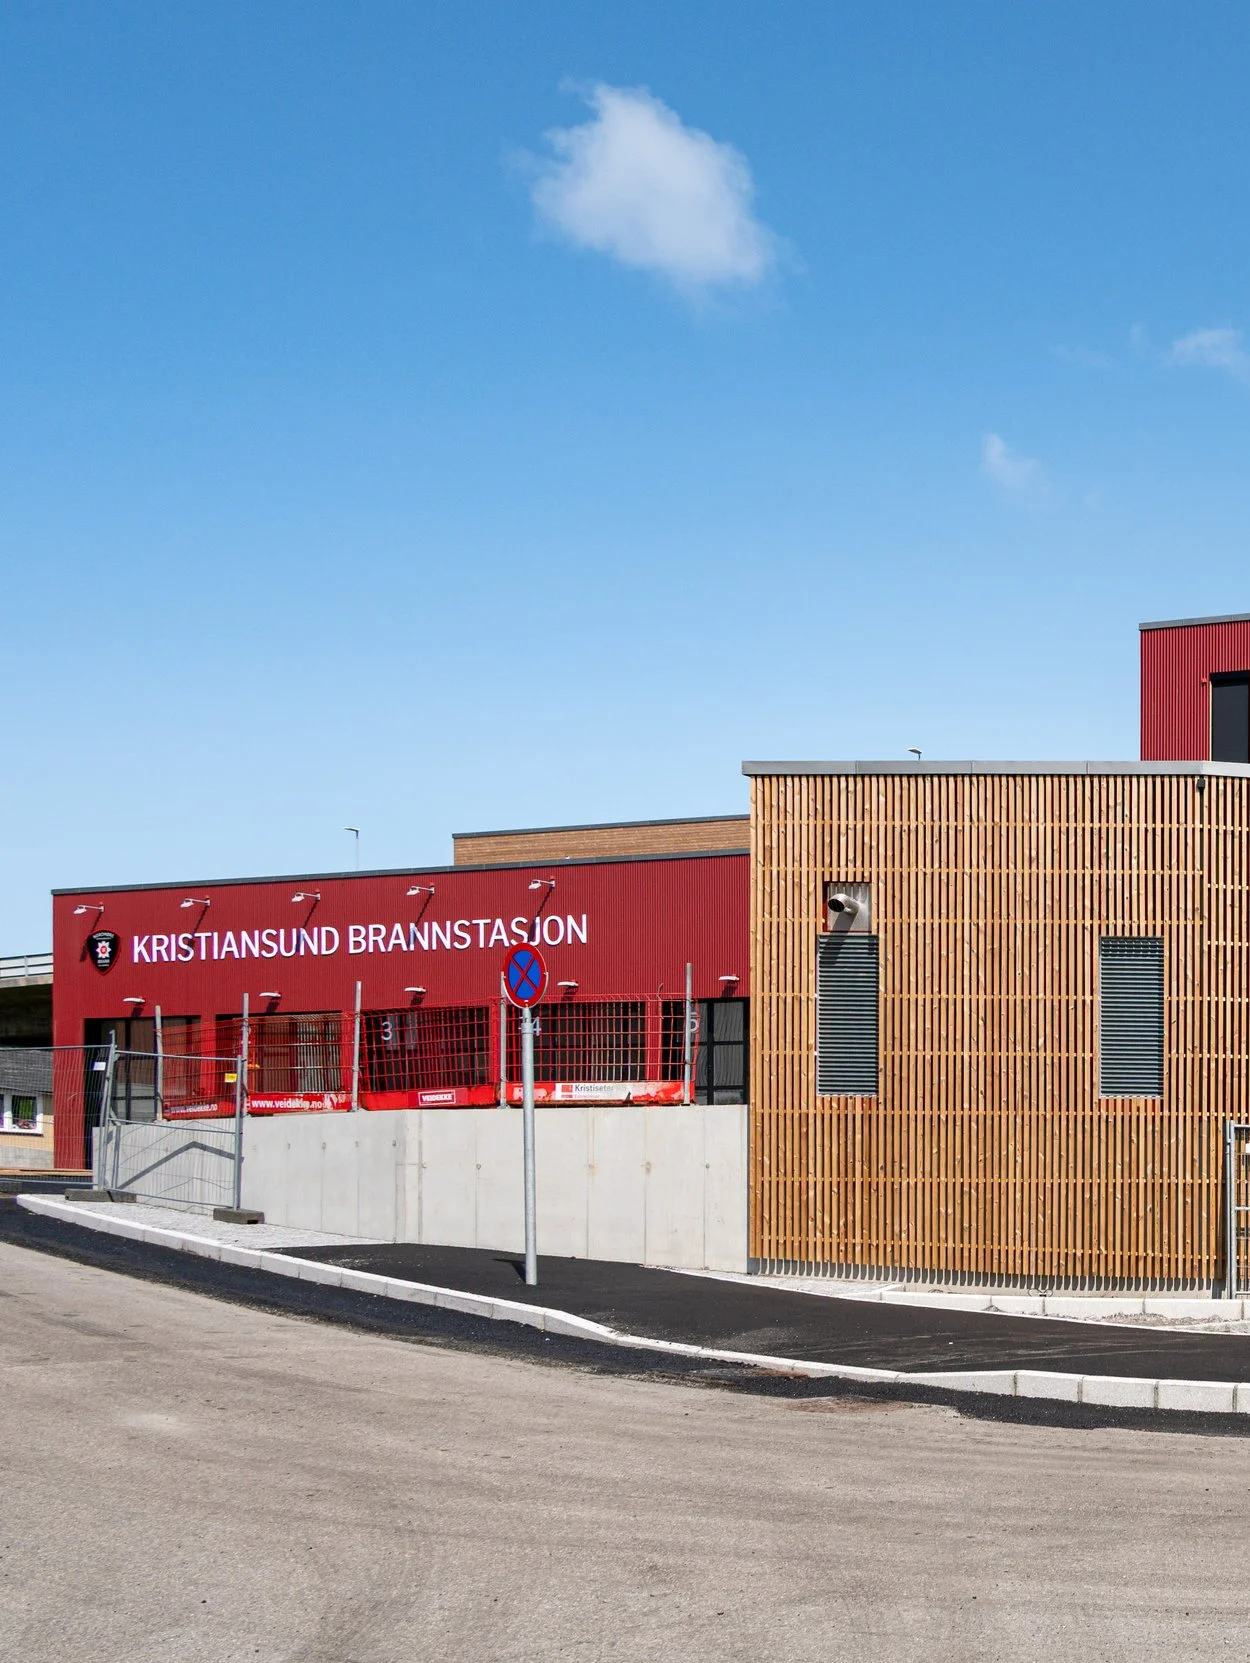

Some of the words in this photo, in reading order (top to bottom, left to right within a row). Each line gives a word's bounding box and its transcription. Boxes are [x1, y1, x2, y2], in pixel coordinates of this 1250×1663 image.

[133, 926, 340, 963] KRISTIANSUND
[348, 914, 587, 954] BRANNSTASJON
[381, 1021, 393, 1041] 3
